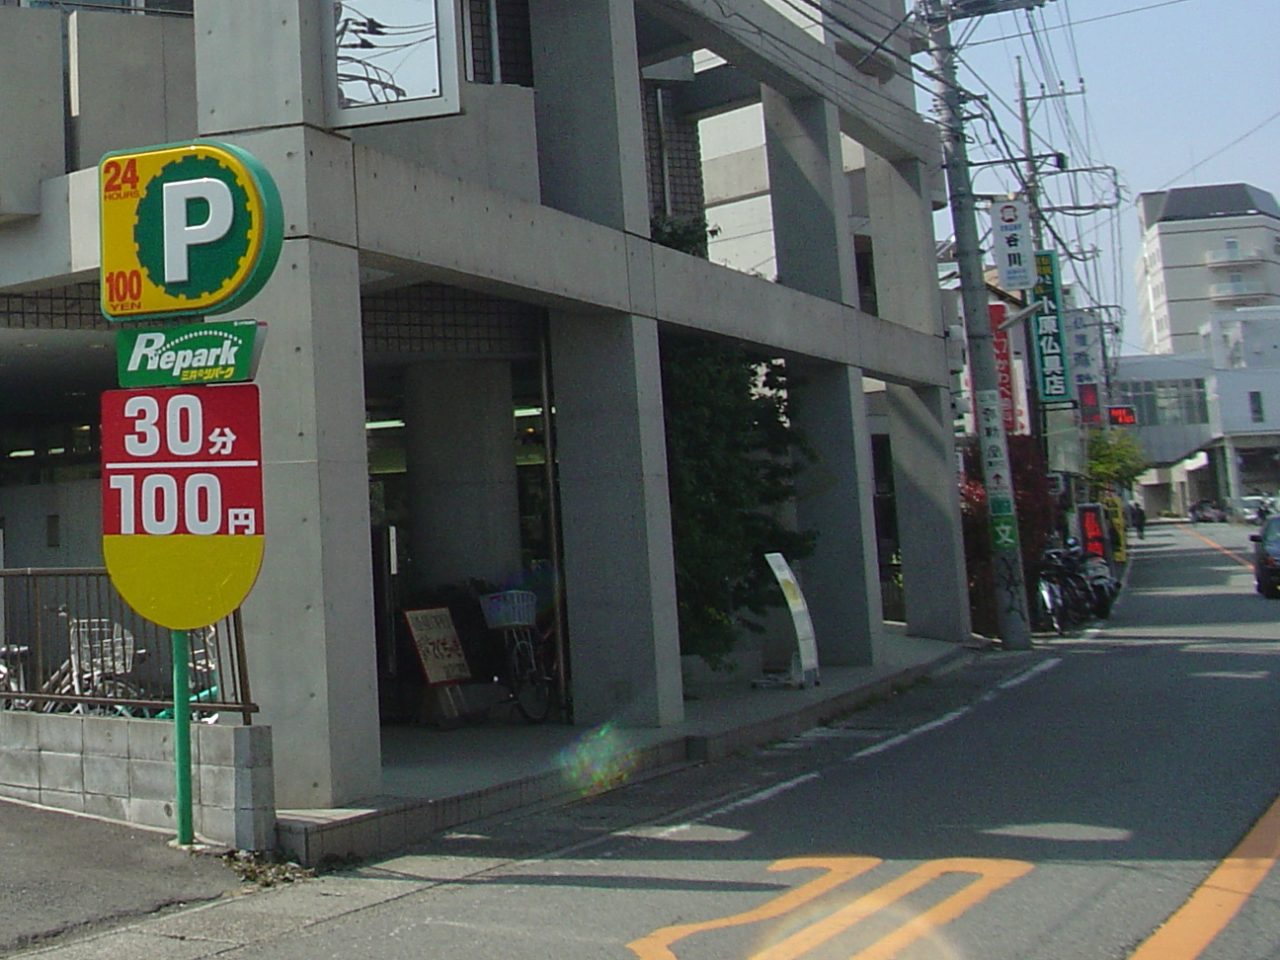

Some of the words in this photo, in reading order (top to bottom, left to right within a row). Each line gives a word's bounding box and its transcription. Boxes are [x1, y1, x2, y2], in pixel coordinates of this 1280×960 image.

[104, 158, 140, 192] 24
[104, 190, 140, 201] HOURS
[163, 177, 234, 283] P
[106, 270, 142, 303] 100
[110, 302, 142, 312] YEN
[127, 332, 239, 376] Repark
[124, 394, 237, 457] 30分
[109, 472, 255, 536] 100円
